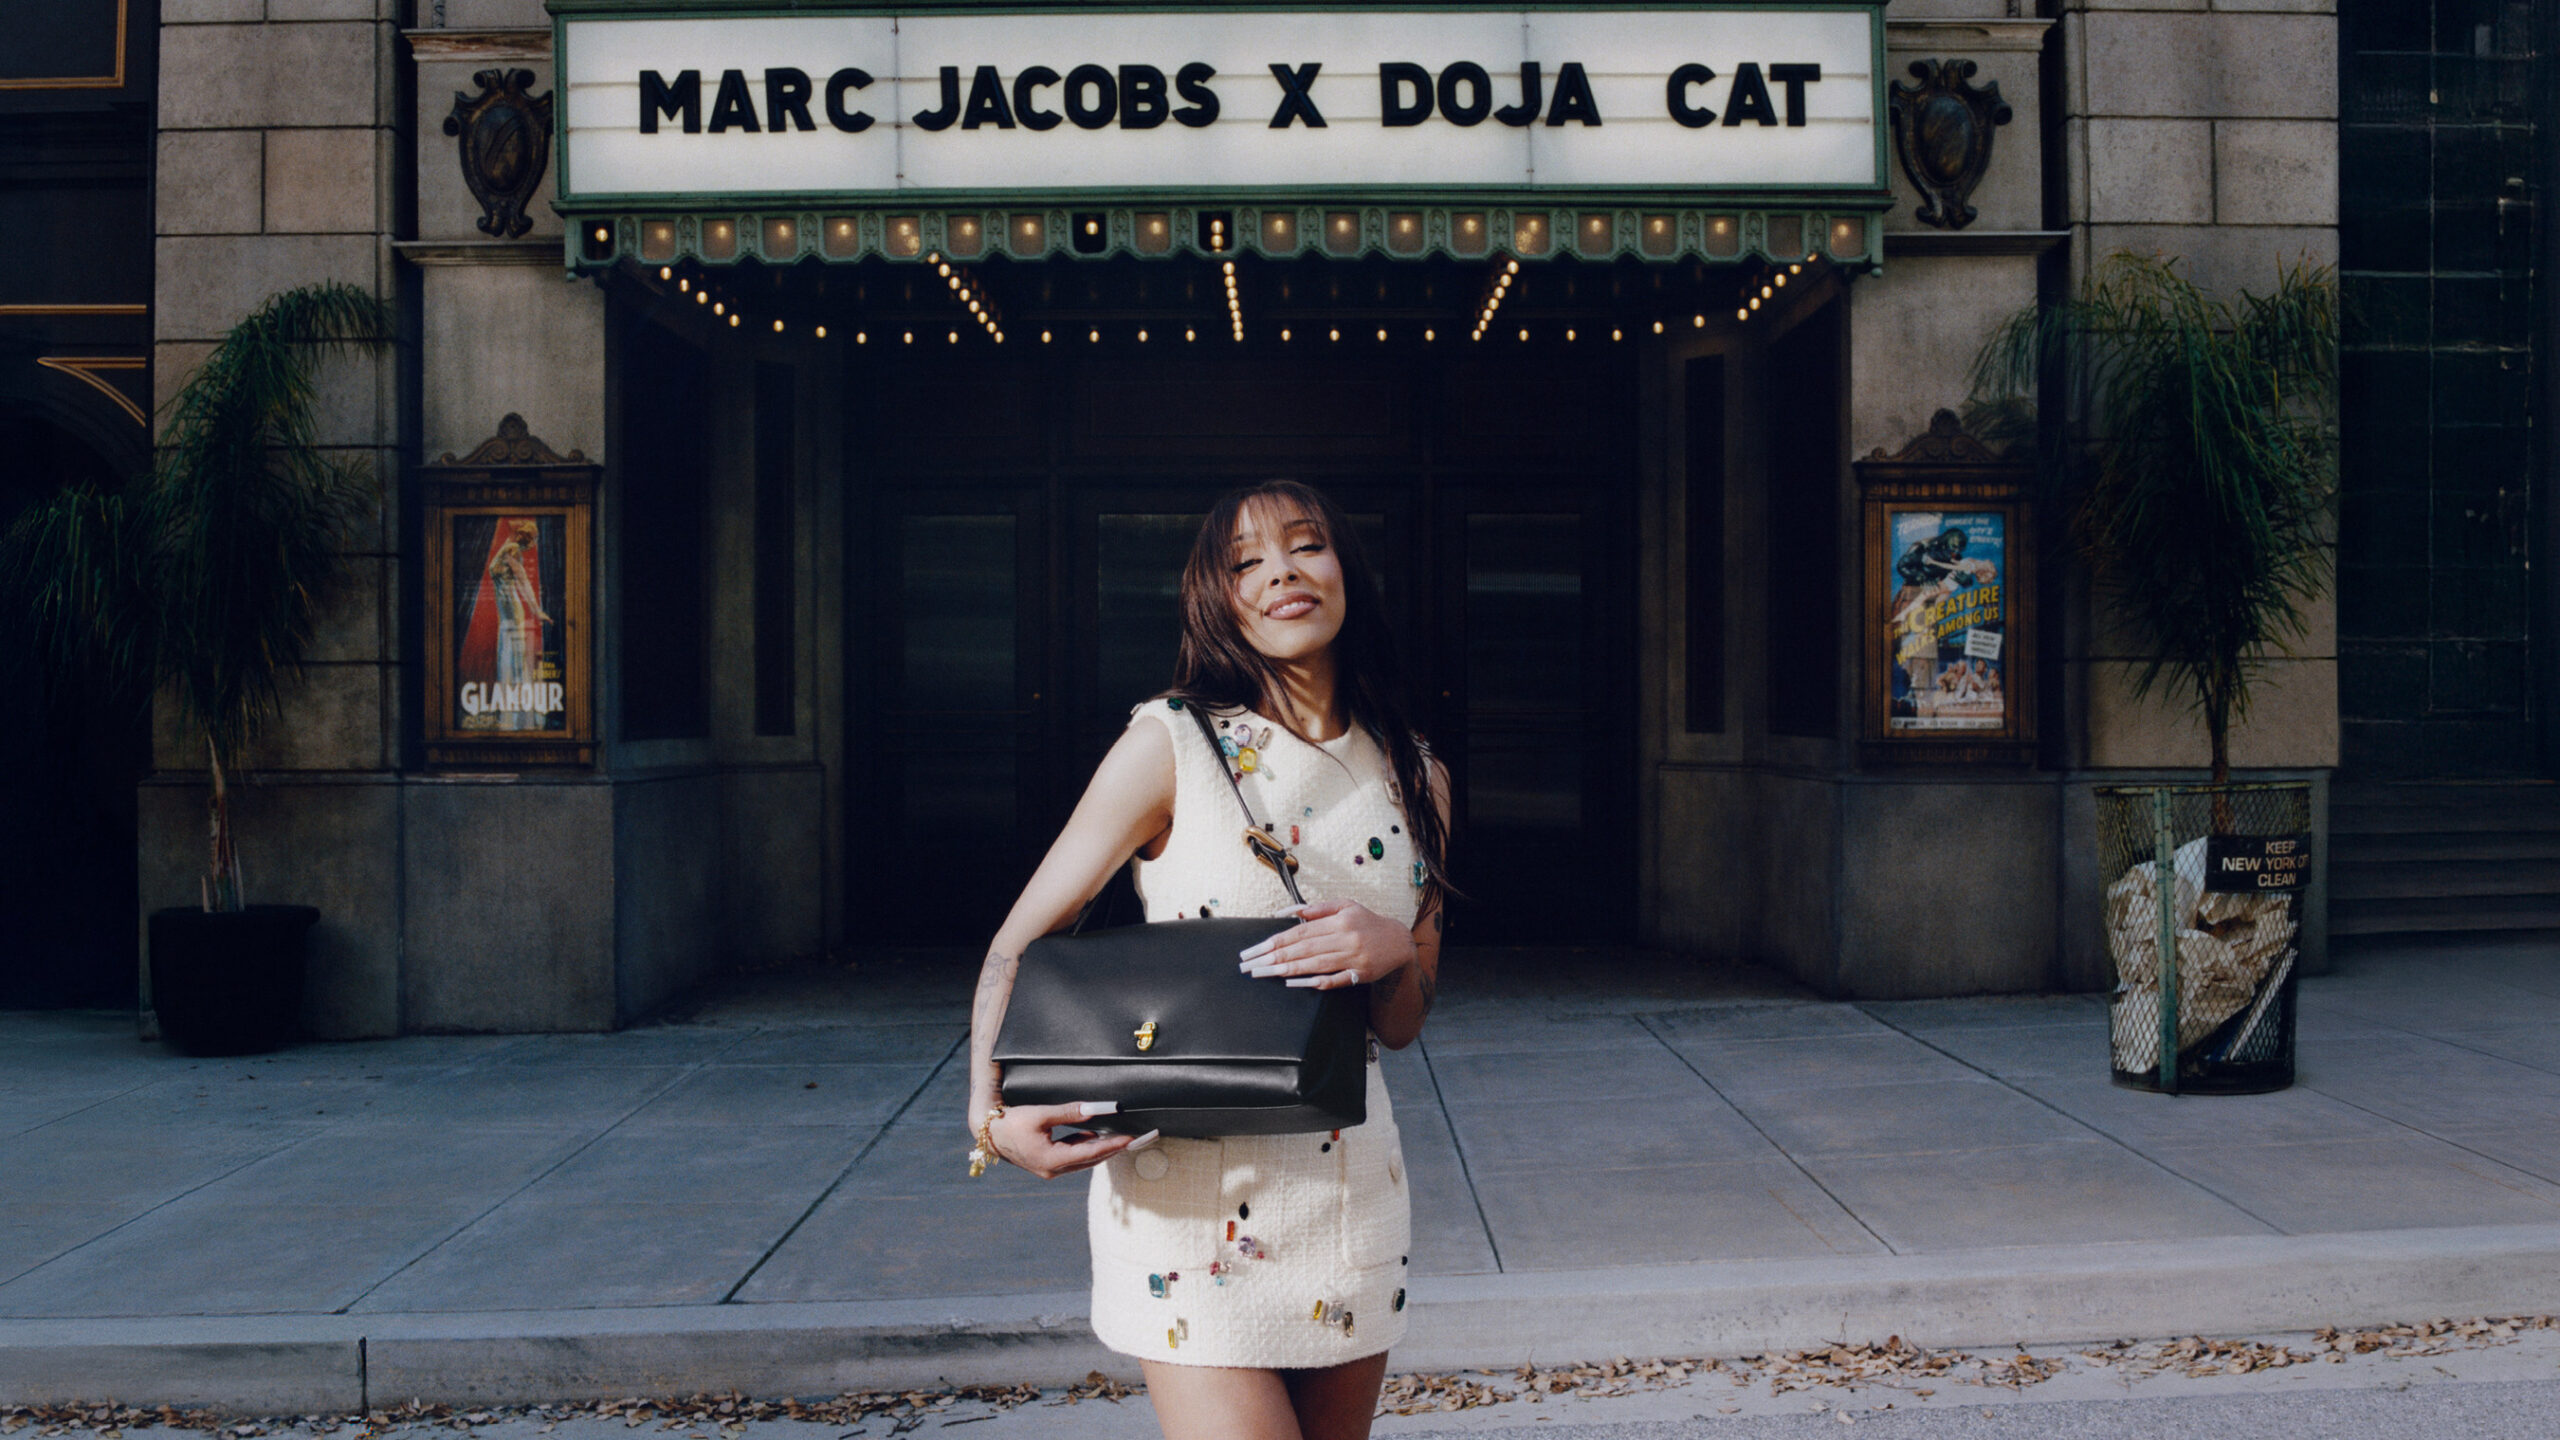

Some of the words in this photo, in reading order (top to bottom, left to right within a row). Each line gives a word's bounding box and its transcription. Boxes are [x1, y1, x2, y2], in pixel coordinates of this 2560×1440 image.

[639, 67, 876, 134] MARC
[911, 62, 1220, 130] JACOBS
[1268, 62, 1328, 128] X
[1379, 61, 1603, 127] DOJA
[1666, 62, 1821, 128] CAT
[1908, 585, 2000, 633] CREATURE
[1937, 609, 1981, 639] AMONG
[1983, 606, 1999, 621] US
[461, 682, 564, 715] GLAMOUR
[2222, 857, 2261, 871] NEW
[2266, 857, 2296, 870] YORK
[2266, 841, 2296, 854] KEEP
[2258, 873, 2296, 887] CLEAN
